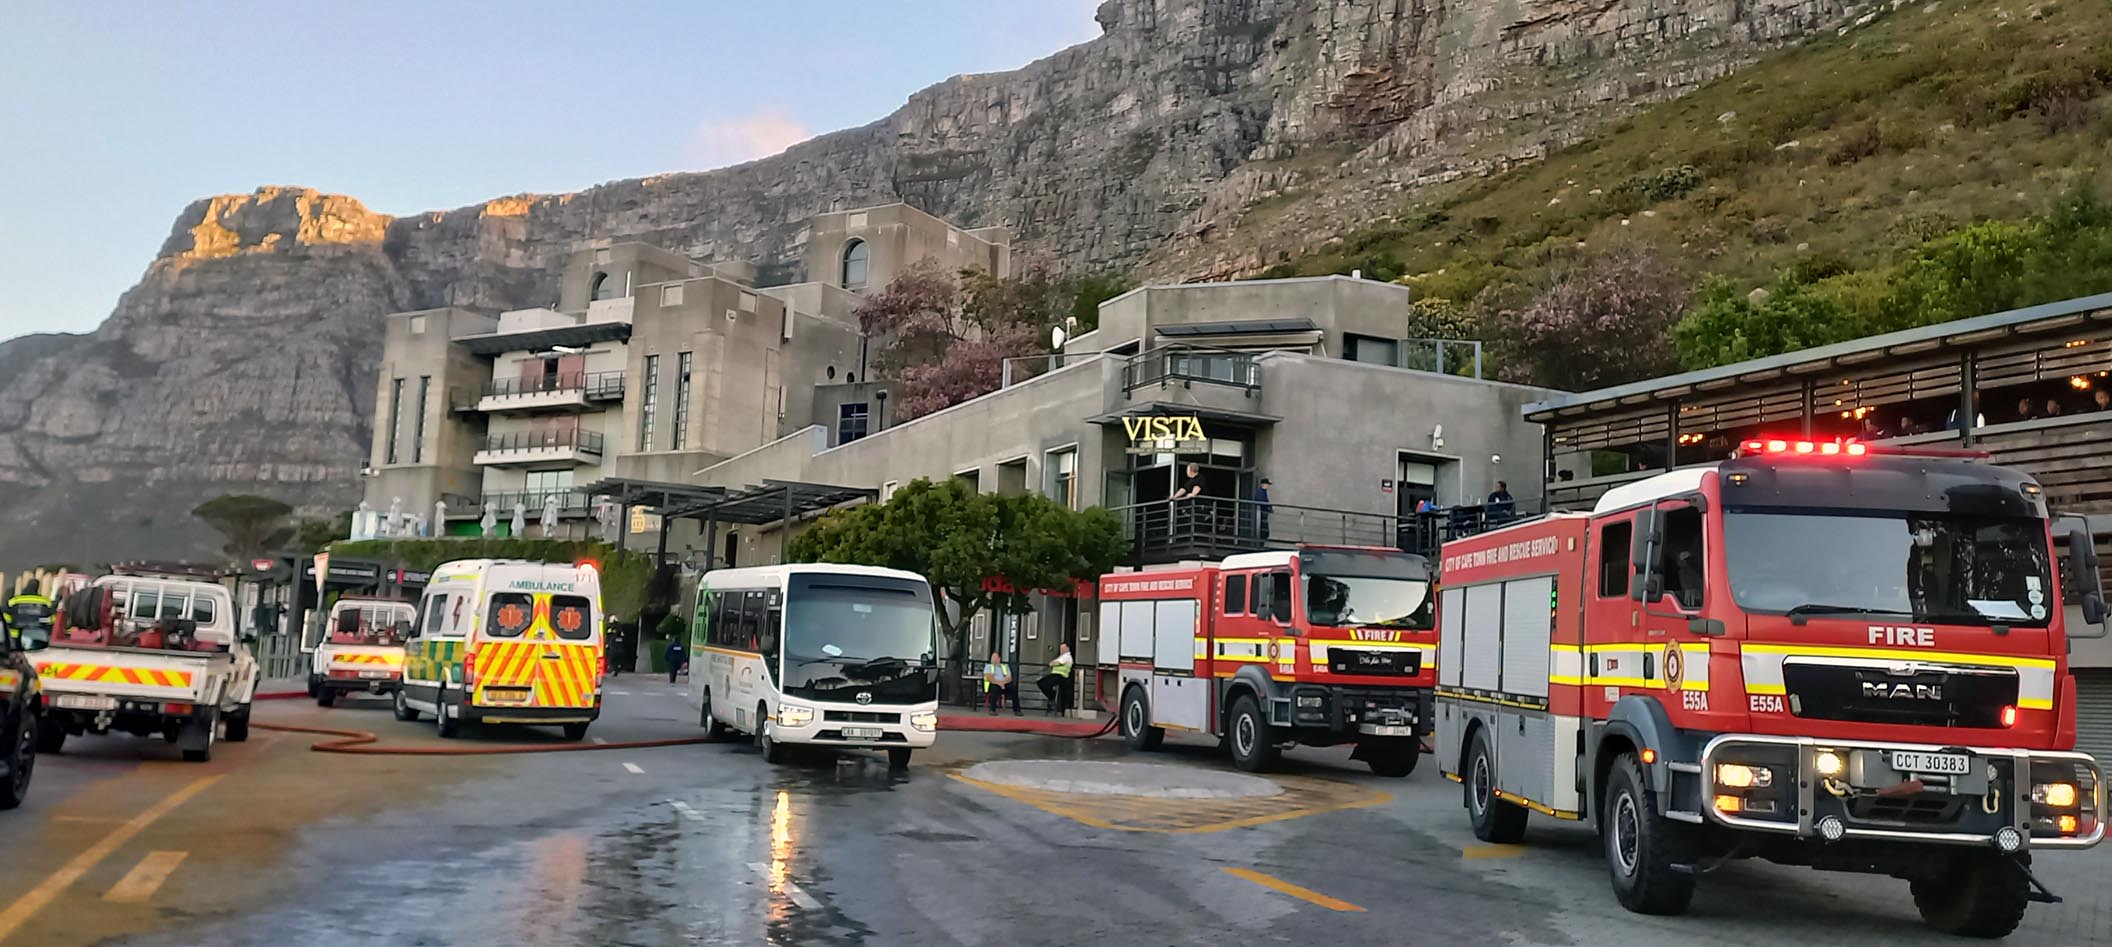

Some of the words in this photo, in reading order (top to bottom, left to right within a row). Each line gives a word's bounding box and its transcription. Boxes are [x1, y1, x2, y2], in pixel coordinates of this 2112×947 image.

[1122, 416, 1207, 441] VISTA
[1445, 557, 1455, 572] CITY
[1455, 555, 1461, 570] OF
[1462, 552, 1473, 569] CAPE
[1473, 550, 1486, 567] TOWN
[1486, 547, 1498, 564] FIRE
[1498, 545, 1508, 562] AND
[1509, 541, 1530, 560] RESCUE
[509, 580, 575, 592] AMBULANCE
[1365, 629, 1387, 642] FIRE
[1868, 625, 1935, 646] FIRE
[1862, 681, 1942, 700] MAN
[1683, 690, 1708, 711] E55A
[1750, 695, 1784, 712] E55A
[1896, 754, 1920, 769] CCT
[1925, 755, 1965, 772] 30383
